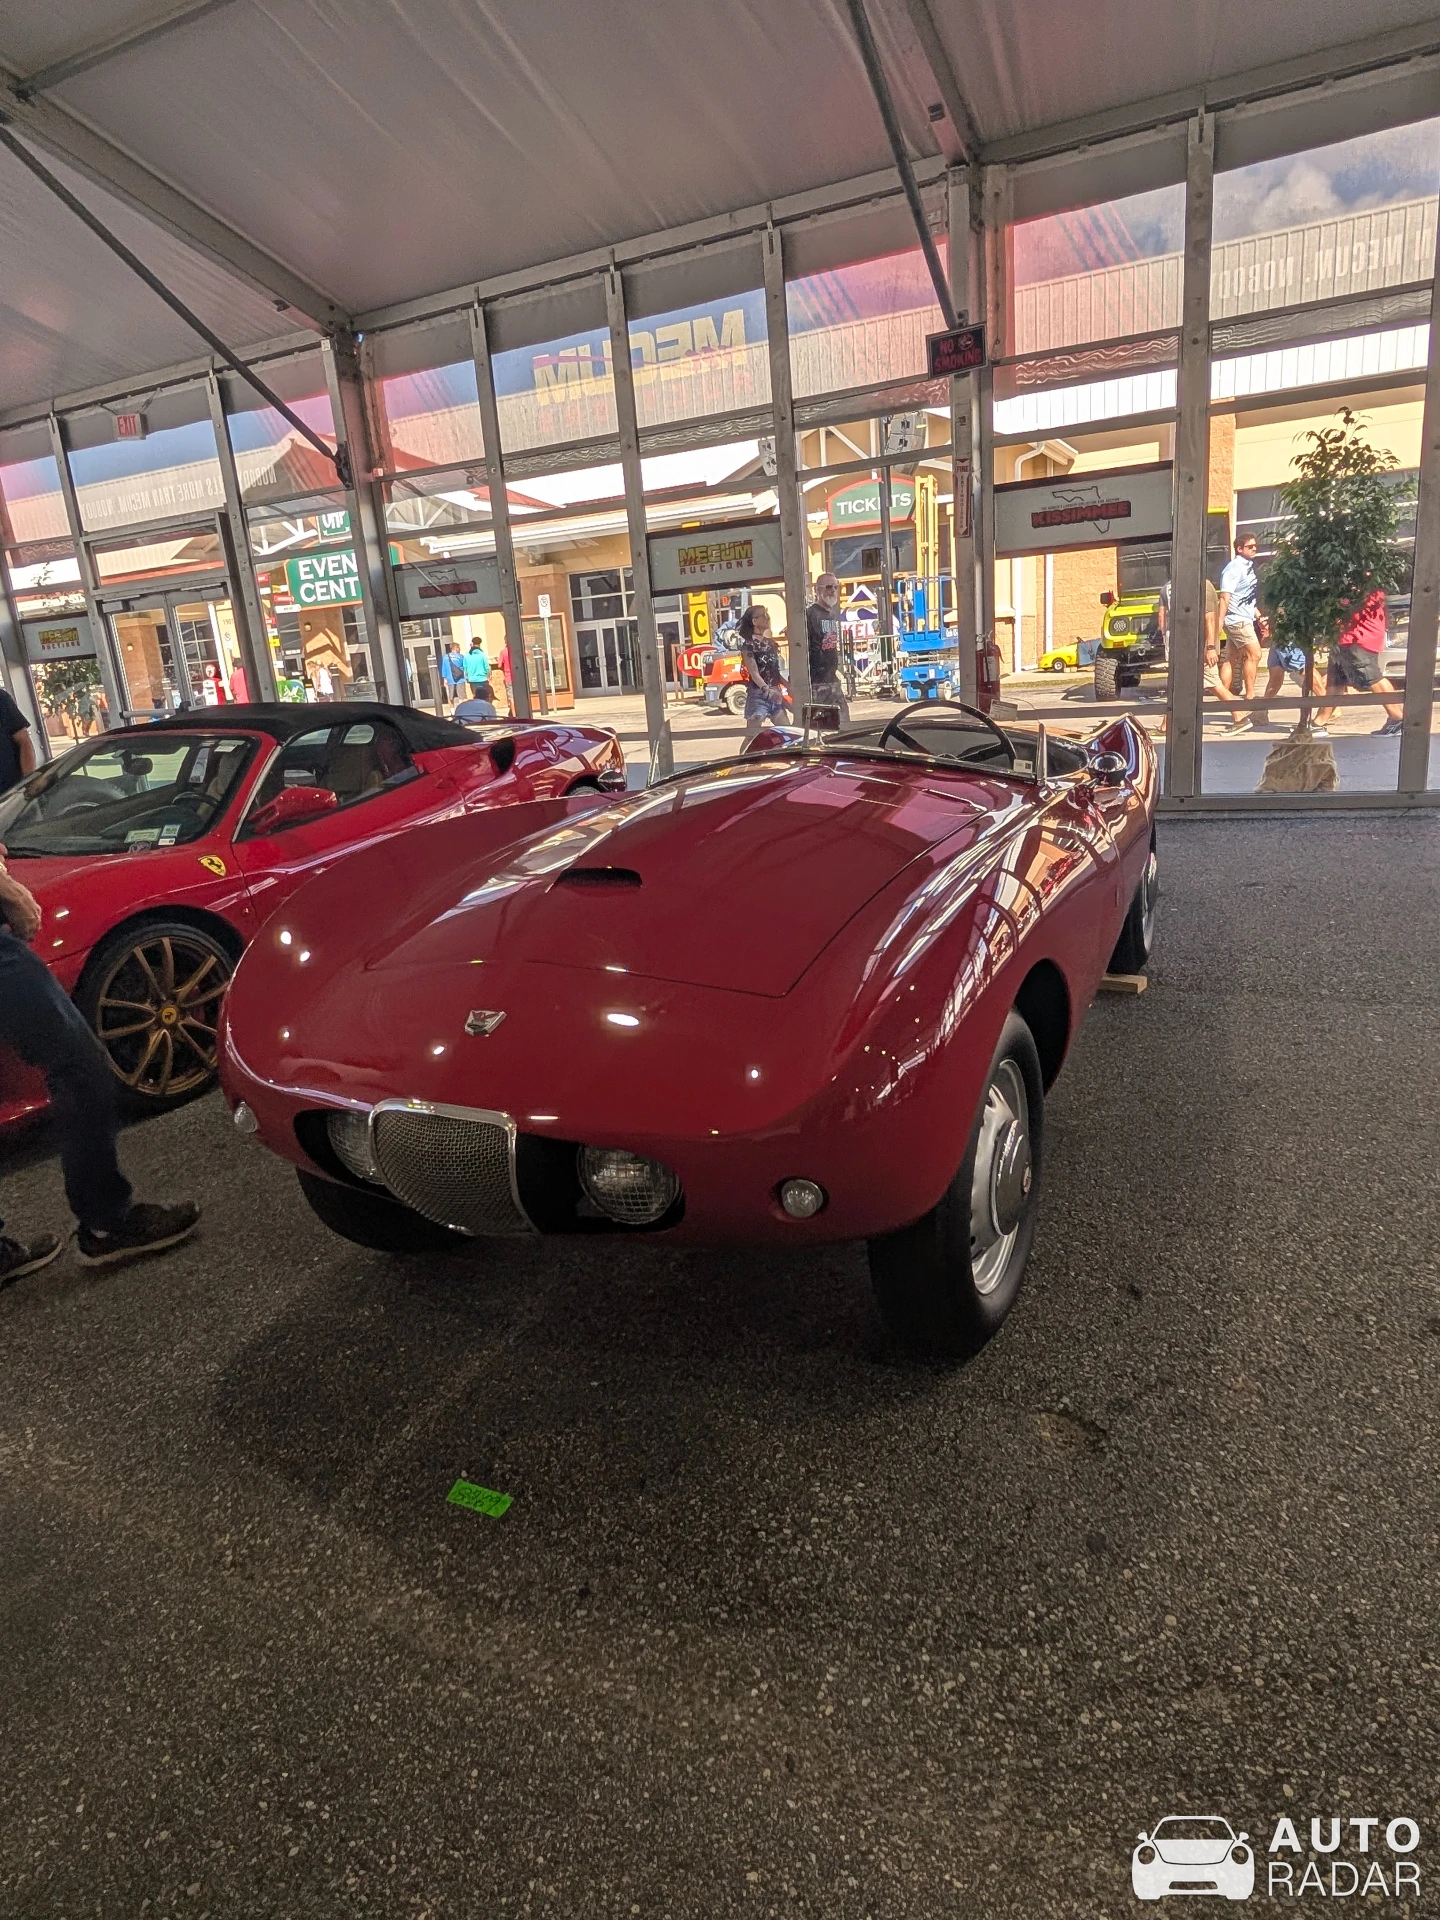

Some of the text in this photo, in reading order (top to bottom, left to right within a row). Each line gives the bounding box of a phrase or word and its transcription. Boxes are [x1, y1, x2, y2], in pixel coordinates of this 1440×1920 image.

[940, 338, 954, 354] NO
[934, 348, 982, 371] SMOKING
[117, 415, 138, 435] EXIT
[1031, 501, 1132, 529] KISSIMMEE
[678, 539, 754, 567] MECUM
[298, 552, 359, 580] EVEN
[680, 559, 754, 575] AUCTIONS
[299, 575, 360, 603] CENT
